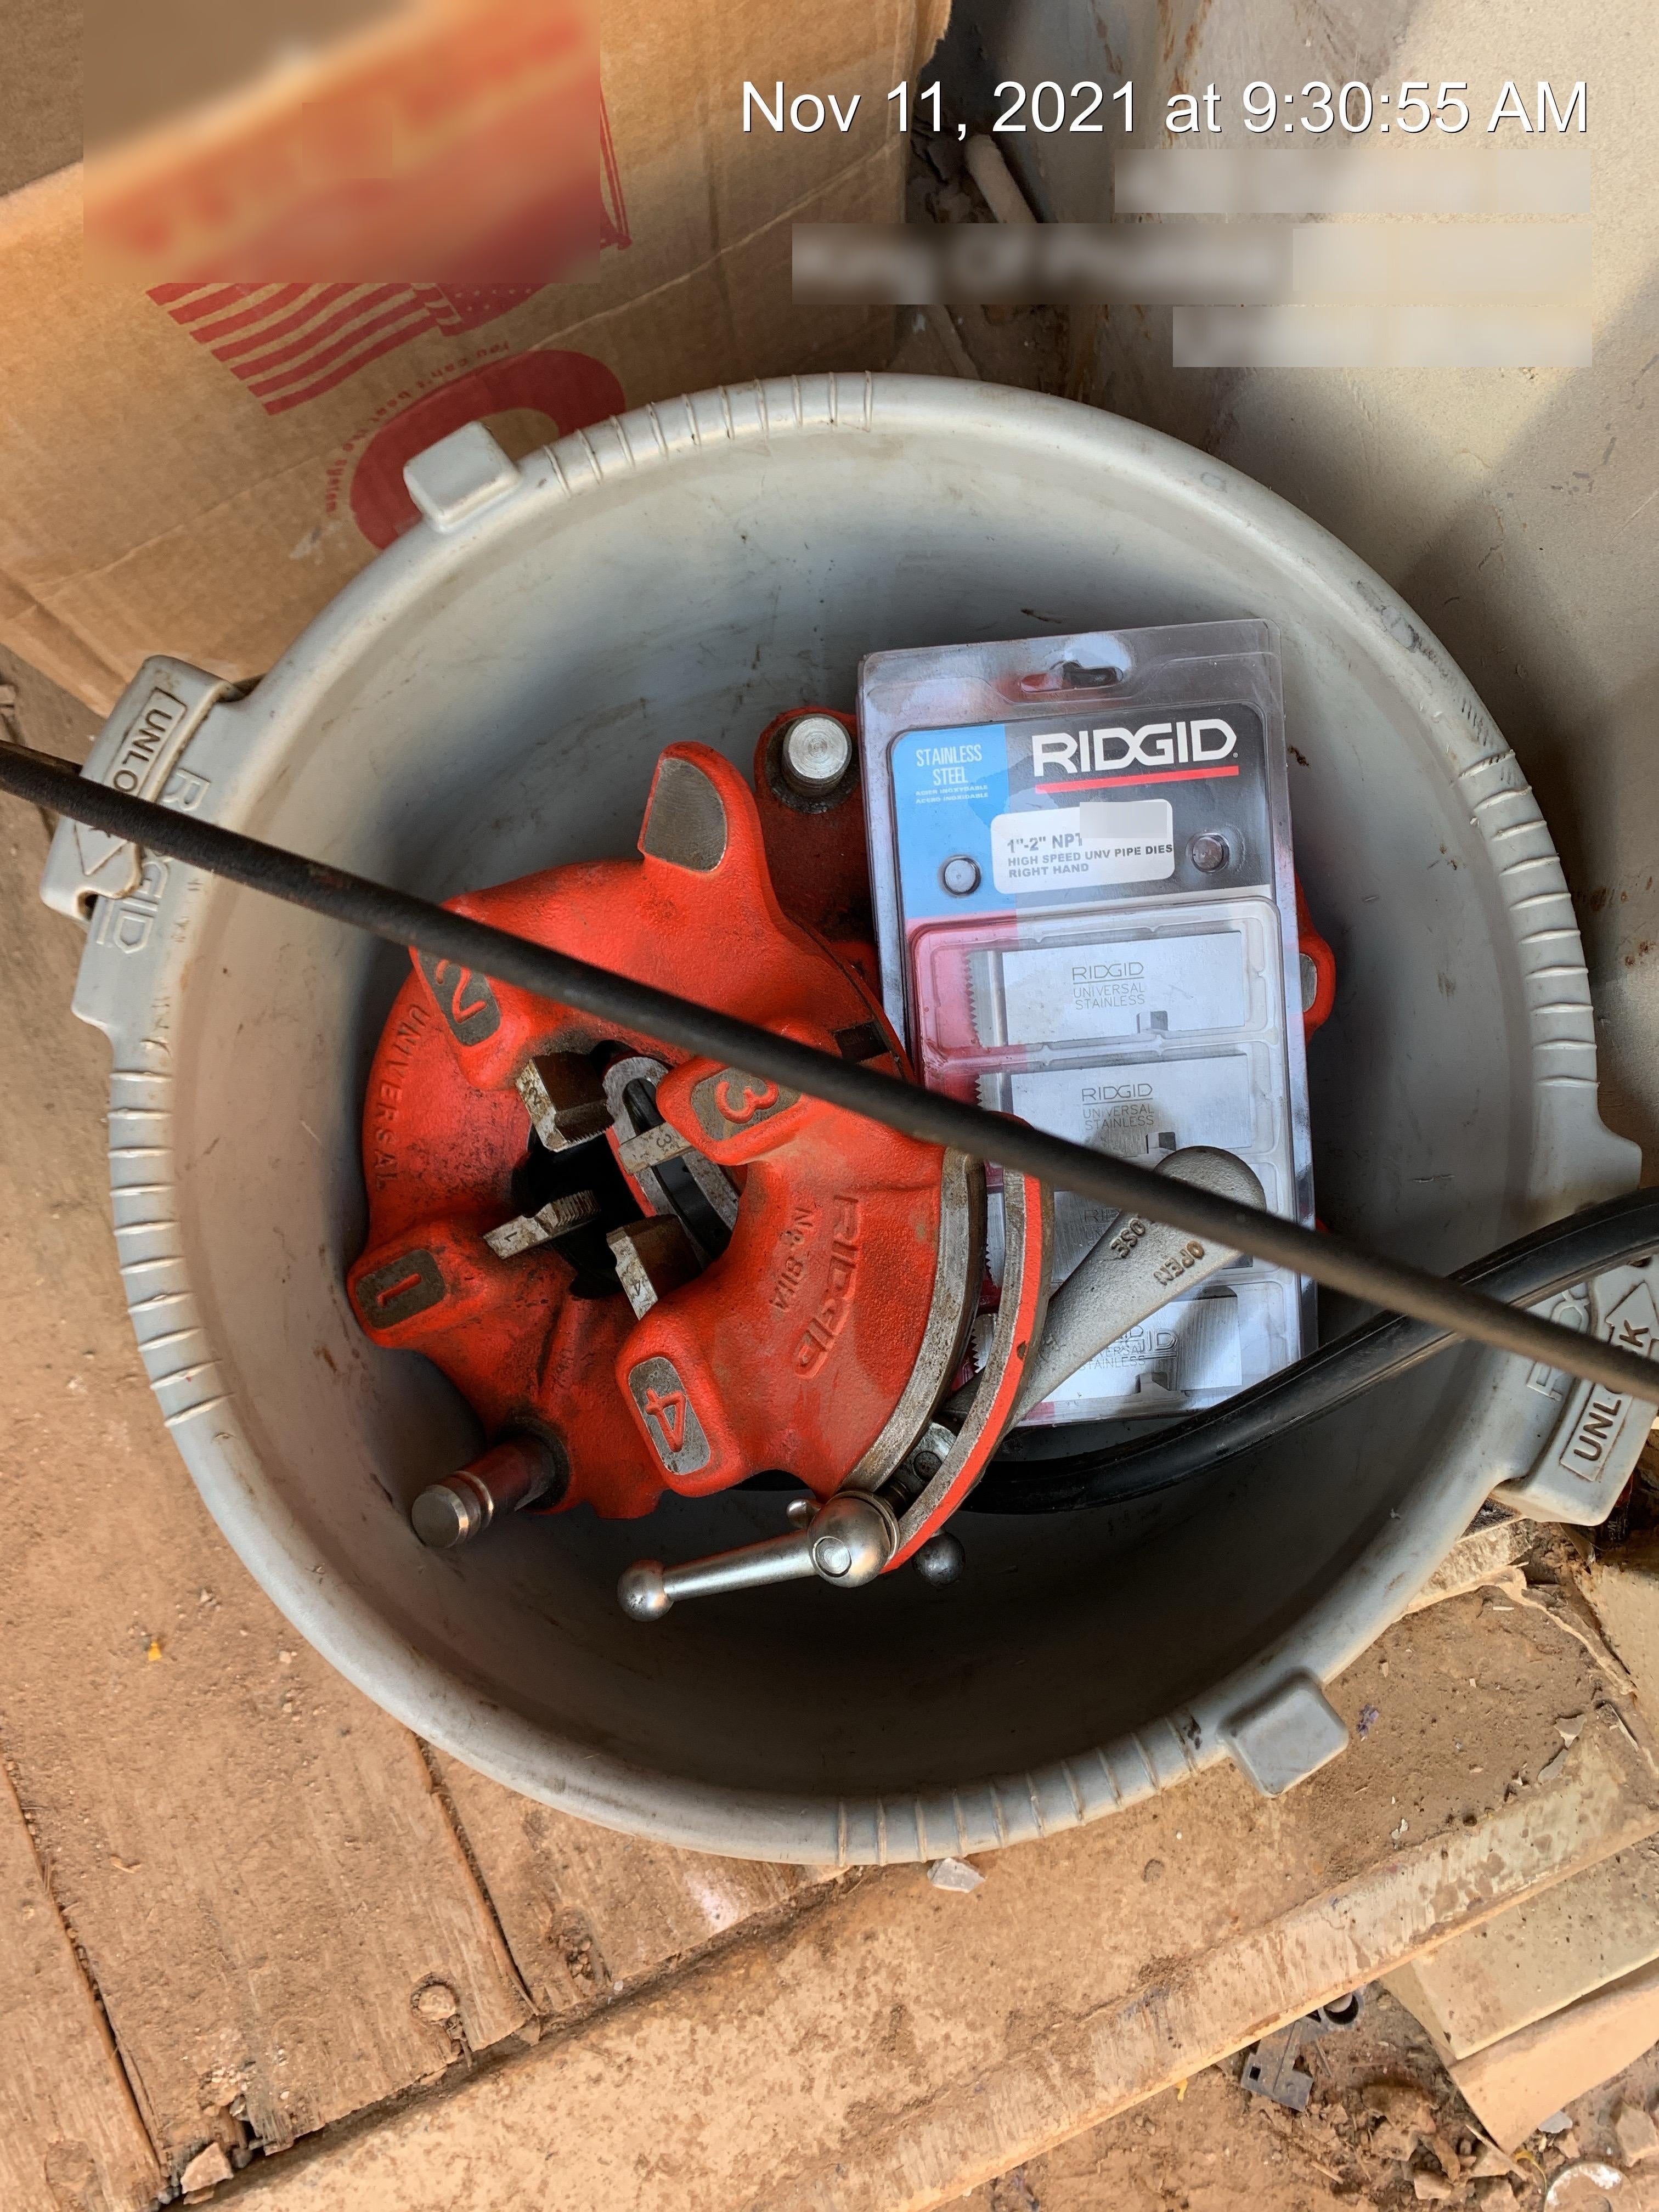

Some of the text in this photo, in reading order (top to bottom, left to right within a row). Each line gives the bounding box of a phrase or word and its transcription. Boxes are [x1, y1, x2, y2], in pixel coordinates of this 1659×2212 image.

[915, 743, 983, 768] STAINLESS
[1031, 718, 1237, 777] RIDGID
[933, 765, 969, 786] STEEL
[1007, 836, 1046, 853] 1"-2"
[1007, 843, 1173, 867] HIGH SPEED UNV PIPE DIES
[1008, 862, 1090, 878] RIGHT HAND
[1072, 962, 1144, 981] RIDGID
[1073, 982, 1146, 998] UNIVERSAL
[1075, 994, 1146, 1011] STAINLESS
[374, 1003, 431, 1192] UNIVERSAL
[715, 1079, 779, 1124] 3
[1081, 1083, 1153, 1102] RIDGID
[1082, 1103, 1155, 1119] UNIVERSAL
[1085, 1115, 1154, 1131] STAINLESS
[1110, 1216, 1146, 1259] OSE
[1153, 1240, 1205, 1286] OPEN
[1574, 1319, 1650, 1462] UNLK
[644, 1386, 688, 1453] 4
